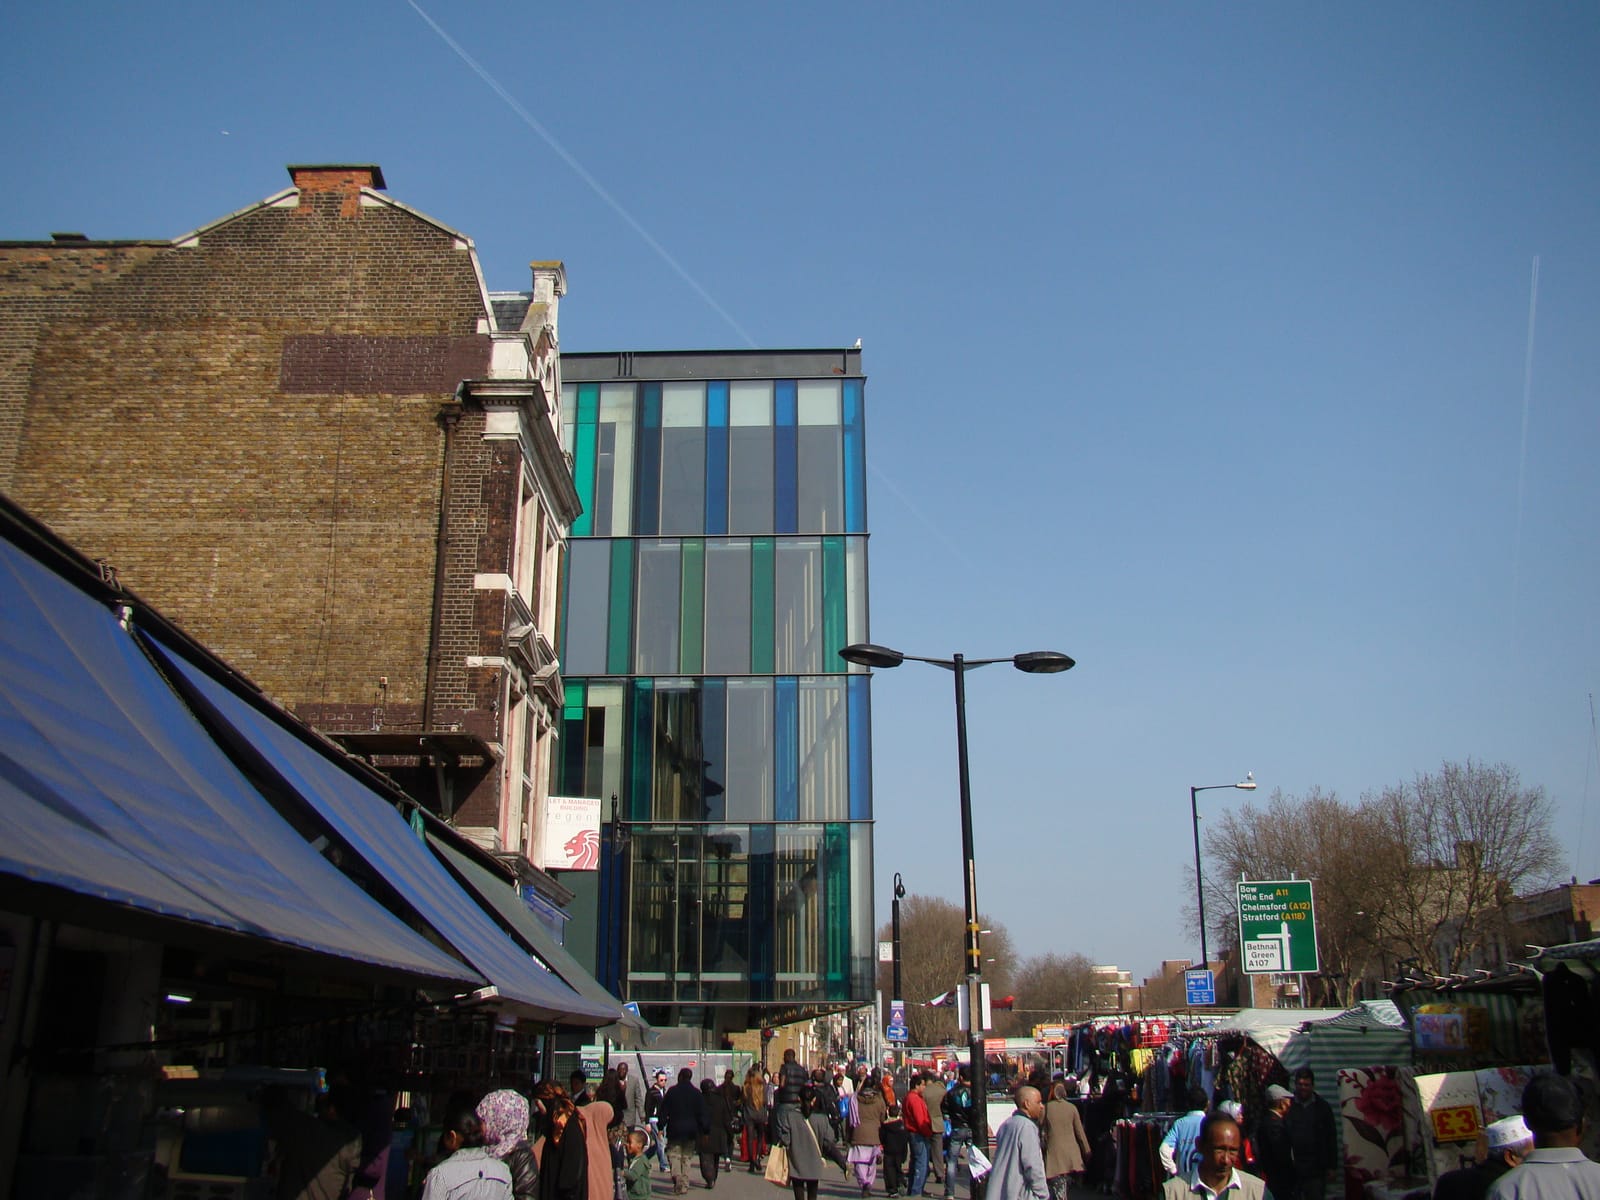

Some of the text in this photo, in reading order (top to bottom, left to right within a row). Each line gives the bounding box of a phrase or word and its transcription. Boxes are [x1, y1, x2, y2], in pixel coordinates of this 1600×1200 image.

[1240, 885, 1257, 893] Bow
[1276, 888, 1289, 896] A11
[1240, 893, 1274, 901] Mile End
[1241, 901, 1311, 911] Chelmsford (A12)
[1242, 912, 1280, 921] Stratford
[1247, 943, 1278, 951] Bethnal
[1251, 951, 1275, 959] Green
[1248, 959, 1269, 967] A107
[583, 1060, 599, 1068] Free
[1436, 1109, 1476, 1135] £3
